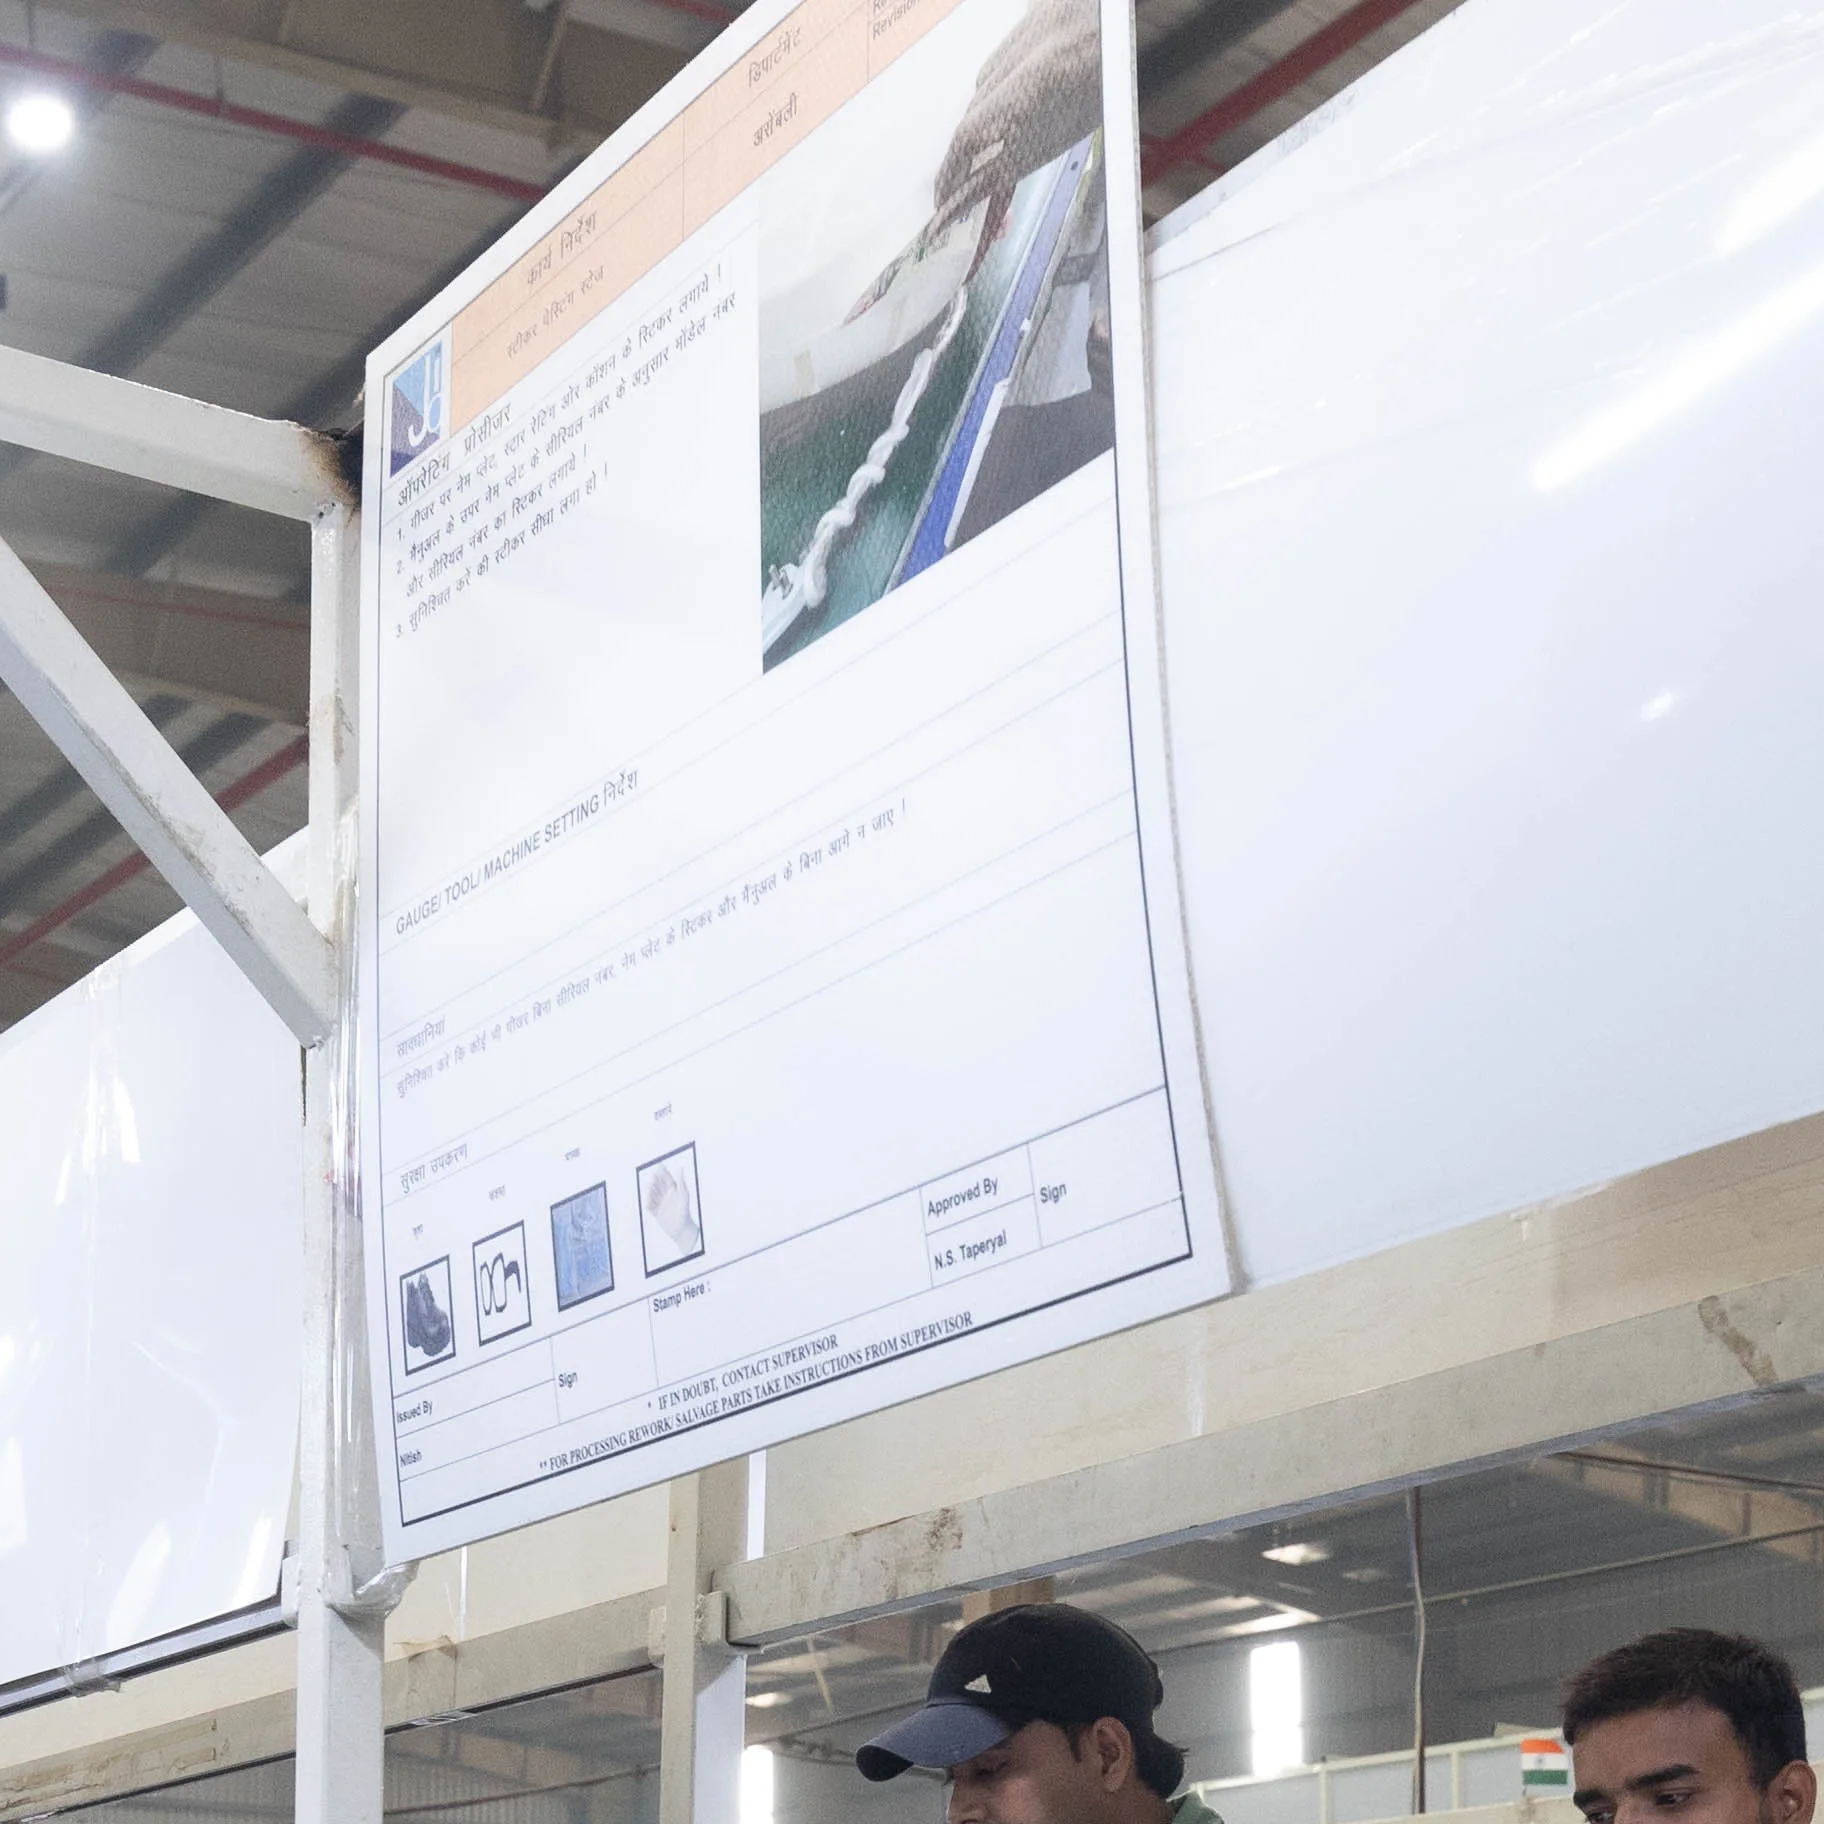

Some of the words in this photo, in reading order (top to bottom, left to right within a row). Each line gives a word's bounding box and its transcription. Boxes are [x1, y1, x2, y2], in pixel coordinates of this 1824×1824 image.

[483, 830, 541, 881] MACHINE
[544, 794, 600, 843] SETTING
[927, 1181, 981, 1217] Approved
[982, 1177, 998, 1196] By
[1039, 1183, 1068, 1205] Sign
[934, 1249, 957, 1270] N.S.
[652, 1292, 682, 1313] Stamp
[683, 1283, 705, 1301] Here
[558, 1372, 578, 1389] Sign
[658, 1394, 669, 1411] IF
[669, 1391, 681, 1407] IN
[681, 1376, 719, 1403] DOUBT,
[721, 1357, 770, 1388] CONTACT
[771, 1333, 839, 1371] SUPERVISOR
[550, 1451, 568, 1472] FOR
[569, 1430, 627, 1465] PROCESSING
[676, 1398, 719, 1428] SALVAGE
[721, 1386, 752, 1413] PARTS
[754, 1376, 782, 1401] TAKE
[784, 1348, 863, 1391] INSTRUCTIONS
[865, 1336, 898, 1363] FROM
[900, 1309, 973, 1351] SUPERVISOR
[396, 1403, 422, 1424] Issued
[422, 1400, 433, 1416] By
